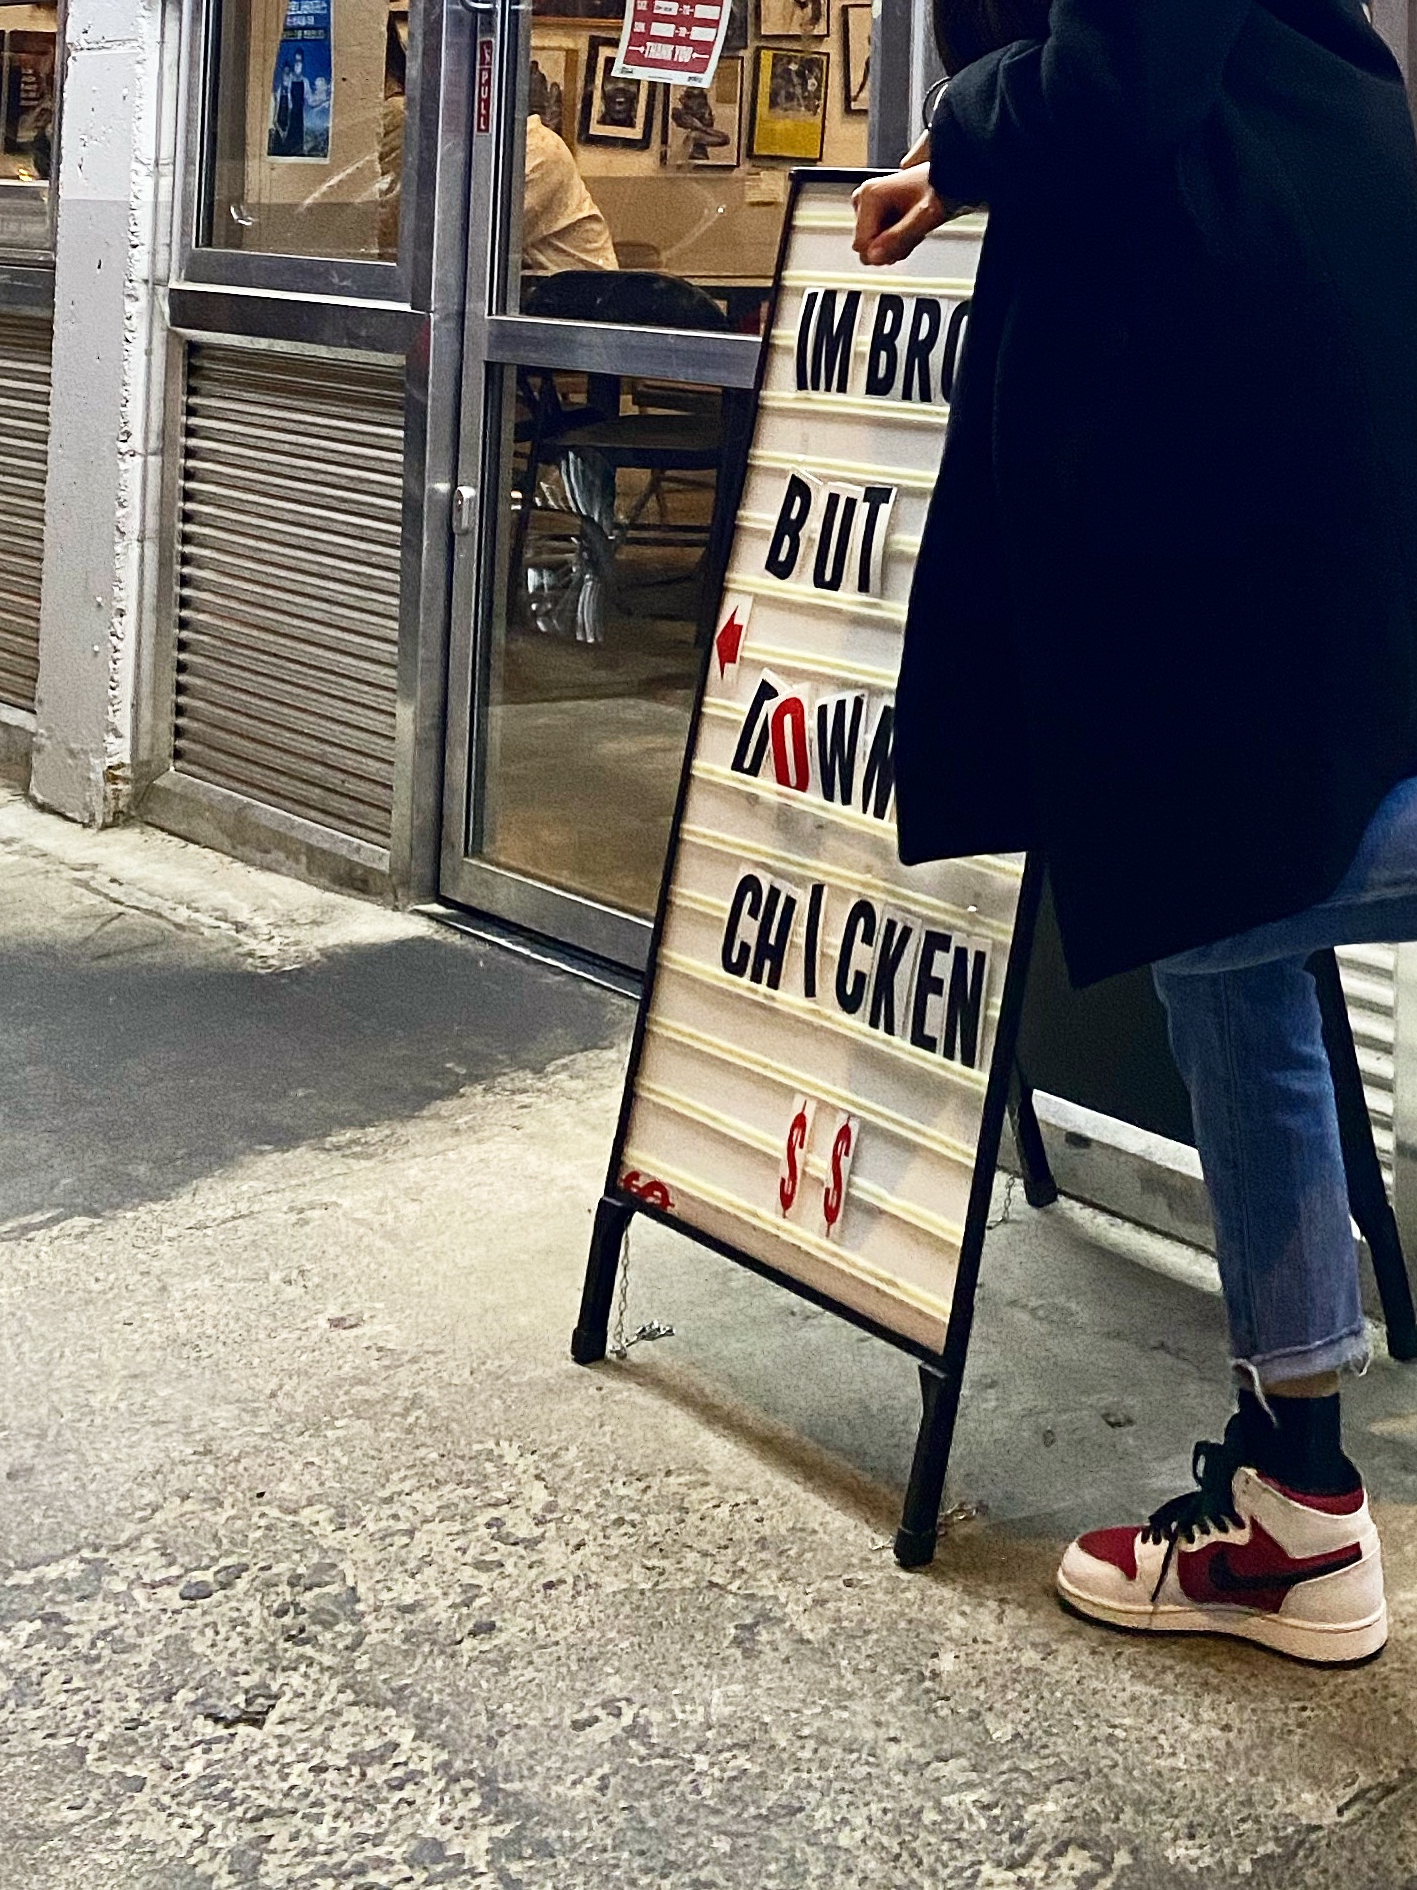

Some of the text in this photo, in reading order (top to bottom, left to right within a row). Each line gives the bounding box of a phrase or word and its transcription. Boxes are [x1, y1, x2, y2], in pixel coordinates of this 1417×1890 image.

[480, 69, 491, 131] PULL
[764, 473, 896, 594] BUT
[721, 873, 987, 1068] CHICKEN
